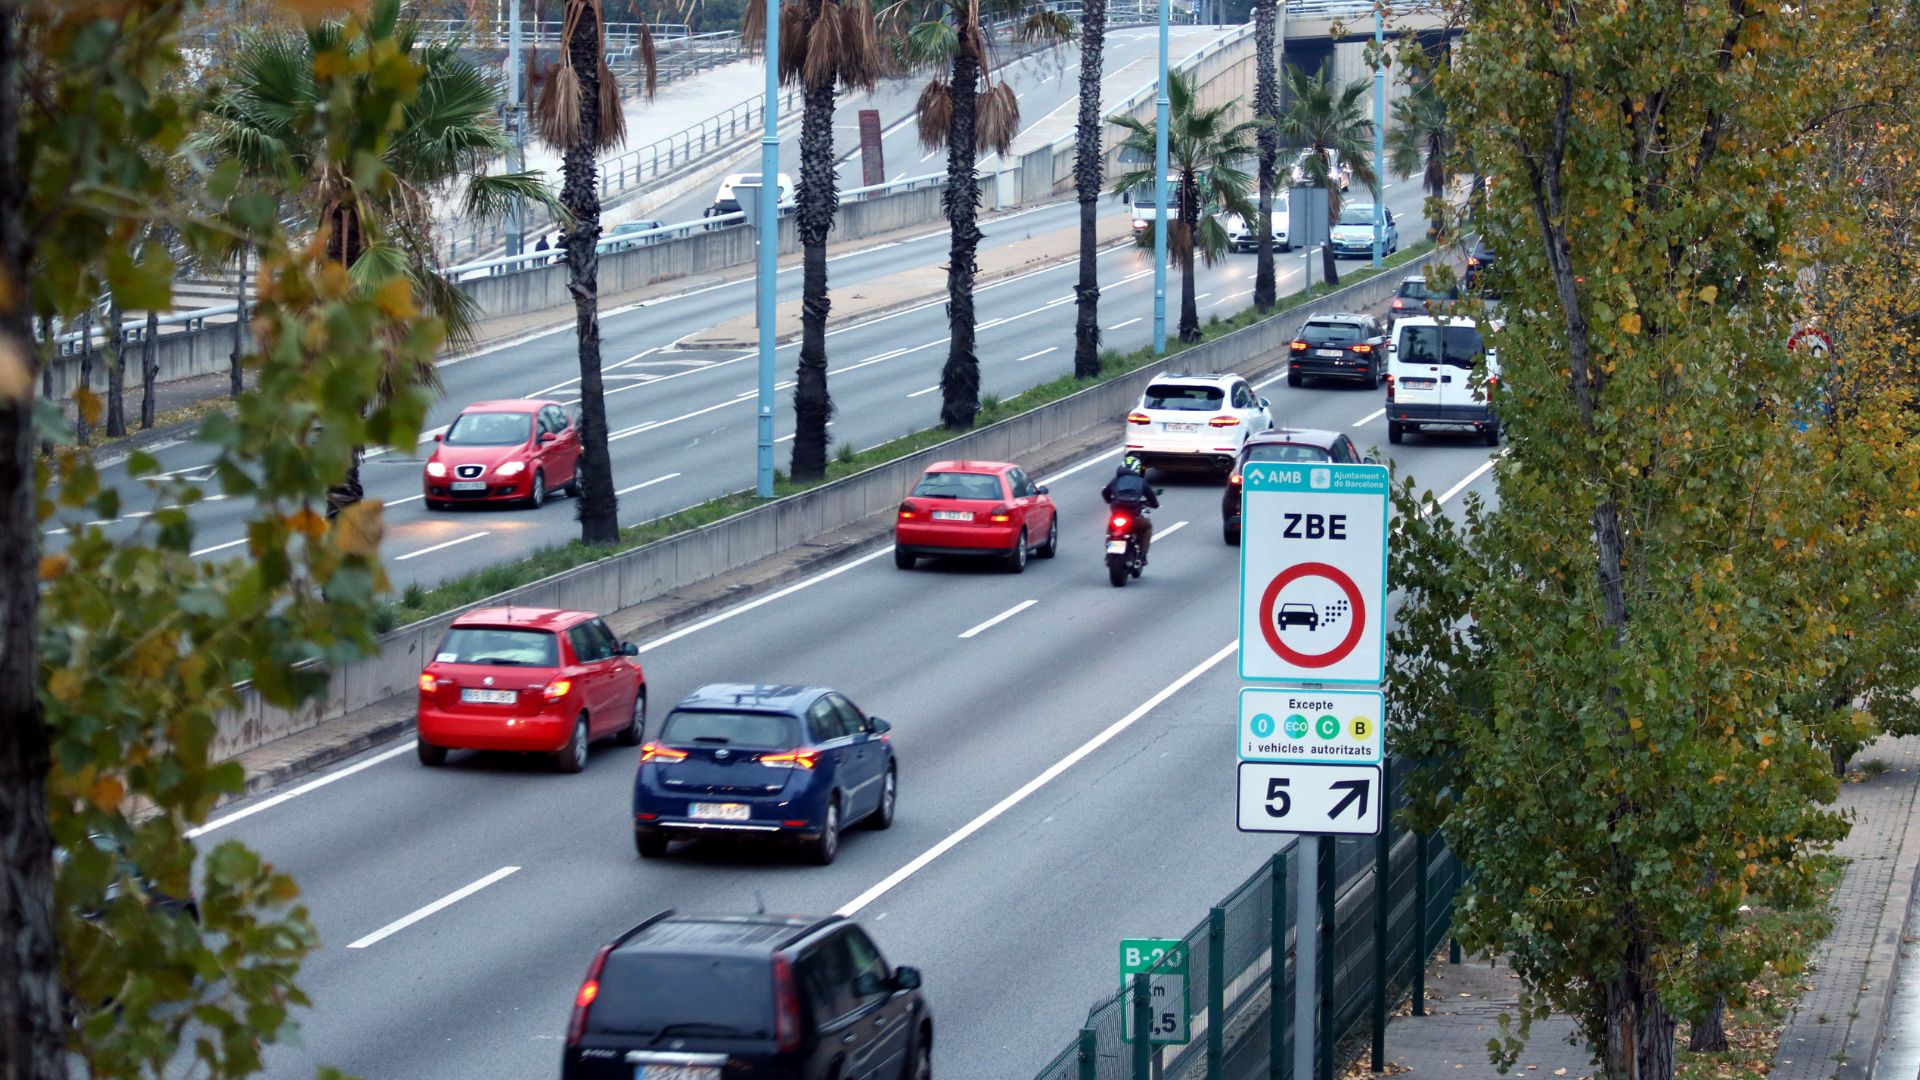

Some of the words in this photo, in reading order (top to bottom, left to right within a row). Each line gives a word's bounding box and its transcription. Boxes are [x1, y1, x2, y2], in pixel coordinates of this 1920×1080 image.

[1267, 470, 1302, 484] AMB
[1333, 471, 1379, 481] Ajuntament
[1333, 480, 1345, 488] de
[1346, 480, 1384, 489] Barcelona
[1283, 512, 1347, 540] ZBE
[1288, 699, 1334, 711] Excepte
[1285, 721, 1308, 732] ECO
[1321, 720, 1334, 735] C
[1355, 721, 1366, 735] B
[1258, 743, 1304, 754] vehicles
[1310, 745, 1372, 756] autoritzats
[1264, 778, 1291, 818] 5
